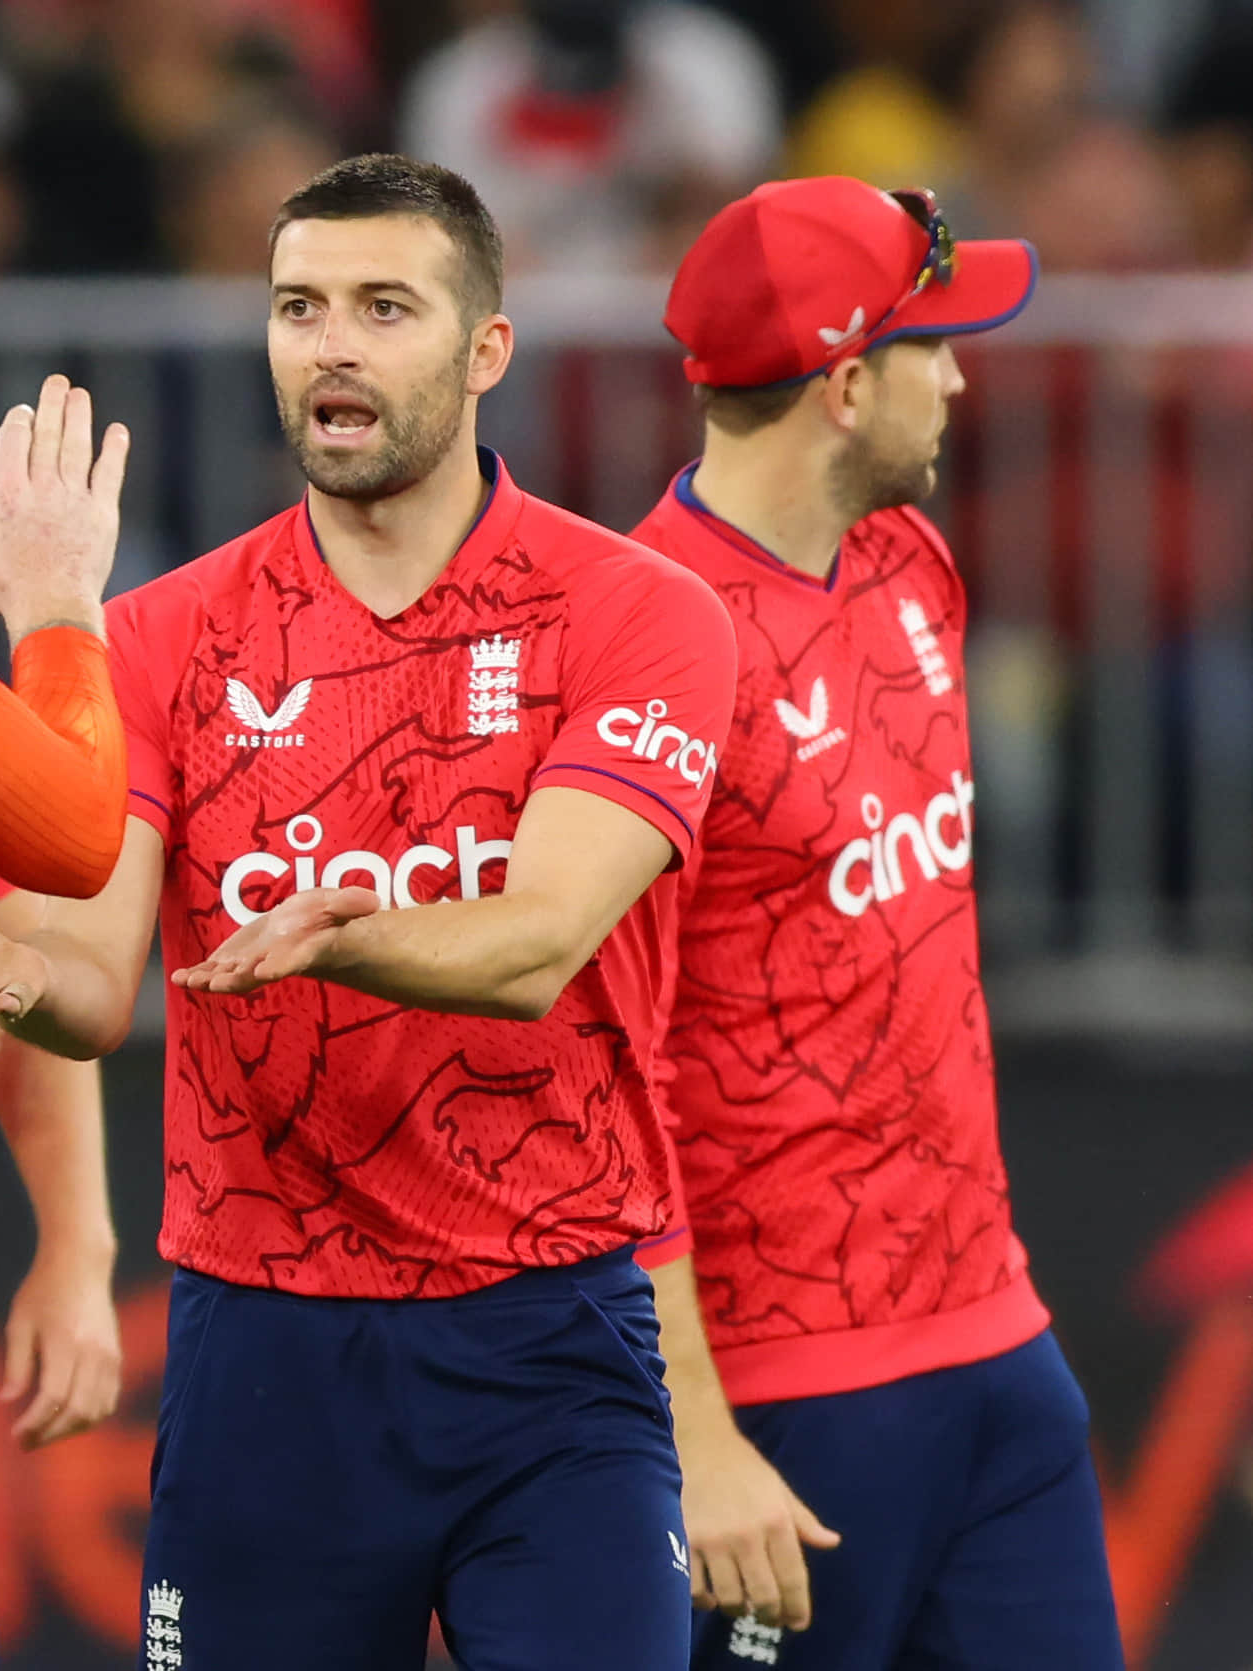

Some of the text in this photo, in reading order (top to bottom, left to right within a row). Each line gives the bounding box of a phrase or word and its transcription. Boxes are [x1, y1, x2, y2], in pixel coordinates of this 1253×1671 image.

[225, 734, 306, 749] CASTORE
[596, 698, 717, 790] cinch
[220, 814, 515, 926] cinch
